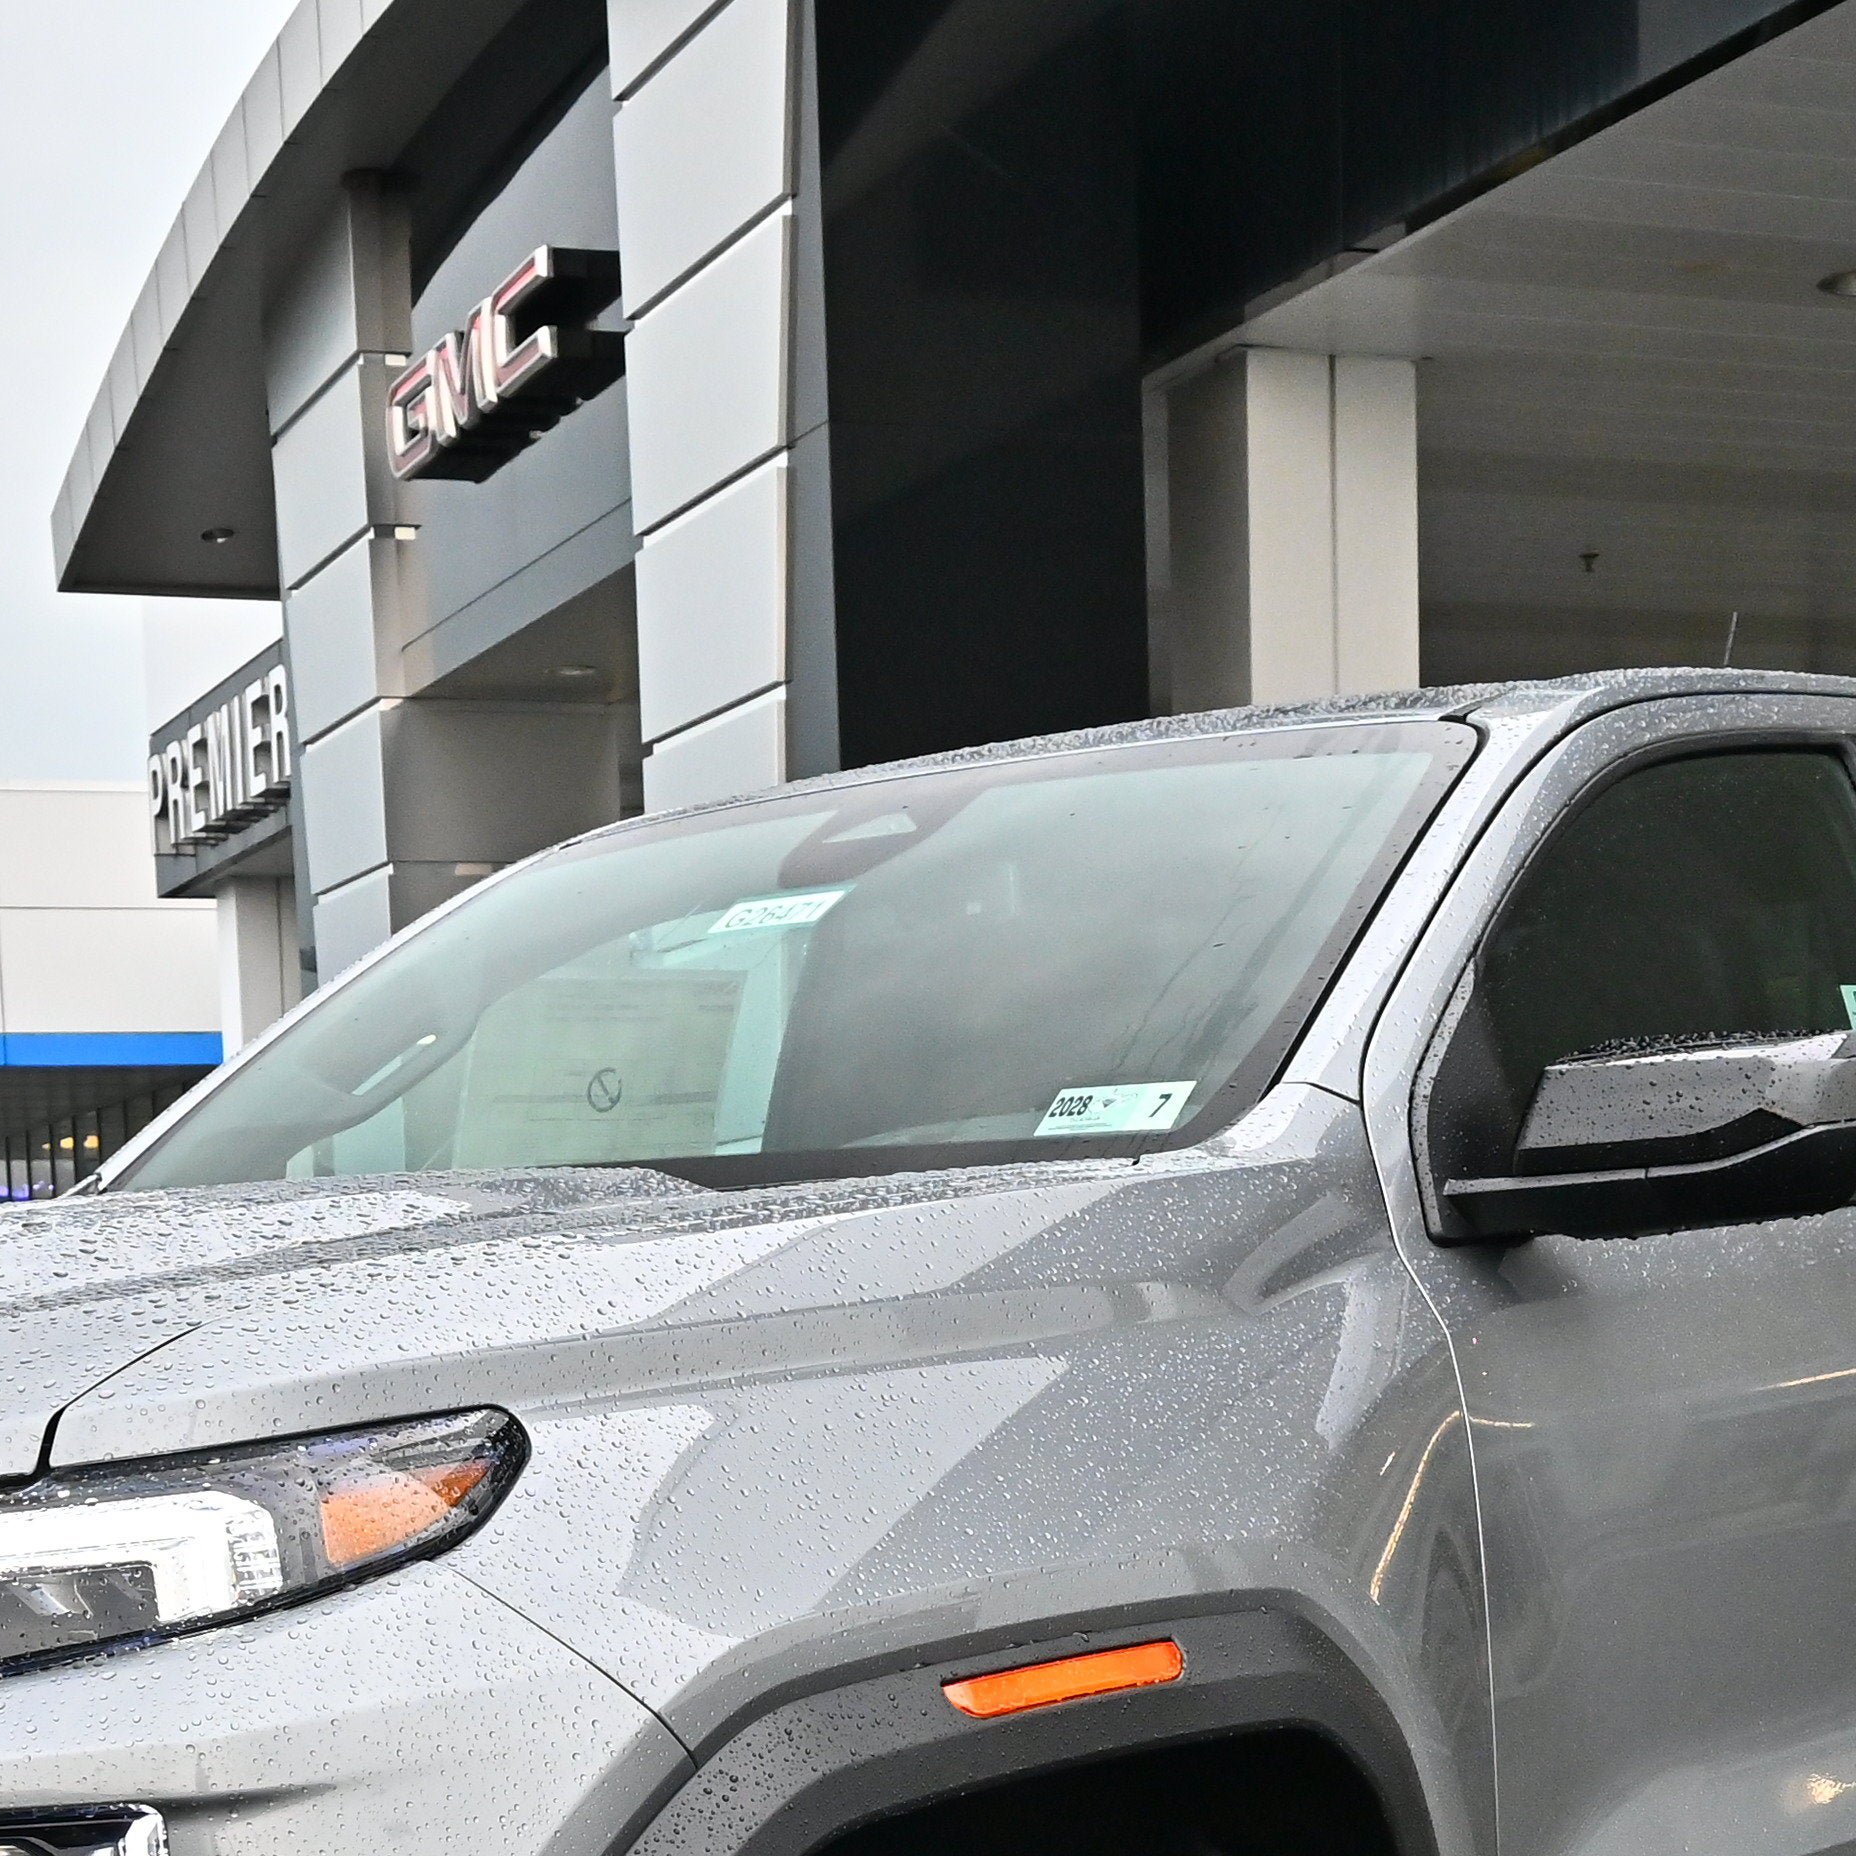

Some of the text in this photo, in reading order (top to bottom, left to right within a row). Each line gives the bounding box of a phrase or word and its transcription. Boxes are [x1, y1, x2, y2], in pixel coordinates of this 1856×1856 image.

[386, 243, 558, 480] GMC
[146, 663, 293, 856] PREMIER
[1048, 1092, 1173, 1118] 2028 7
